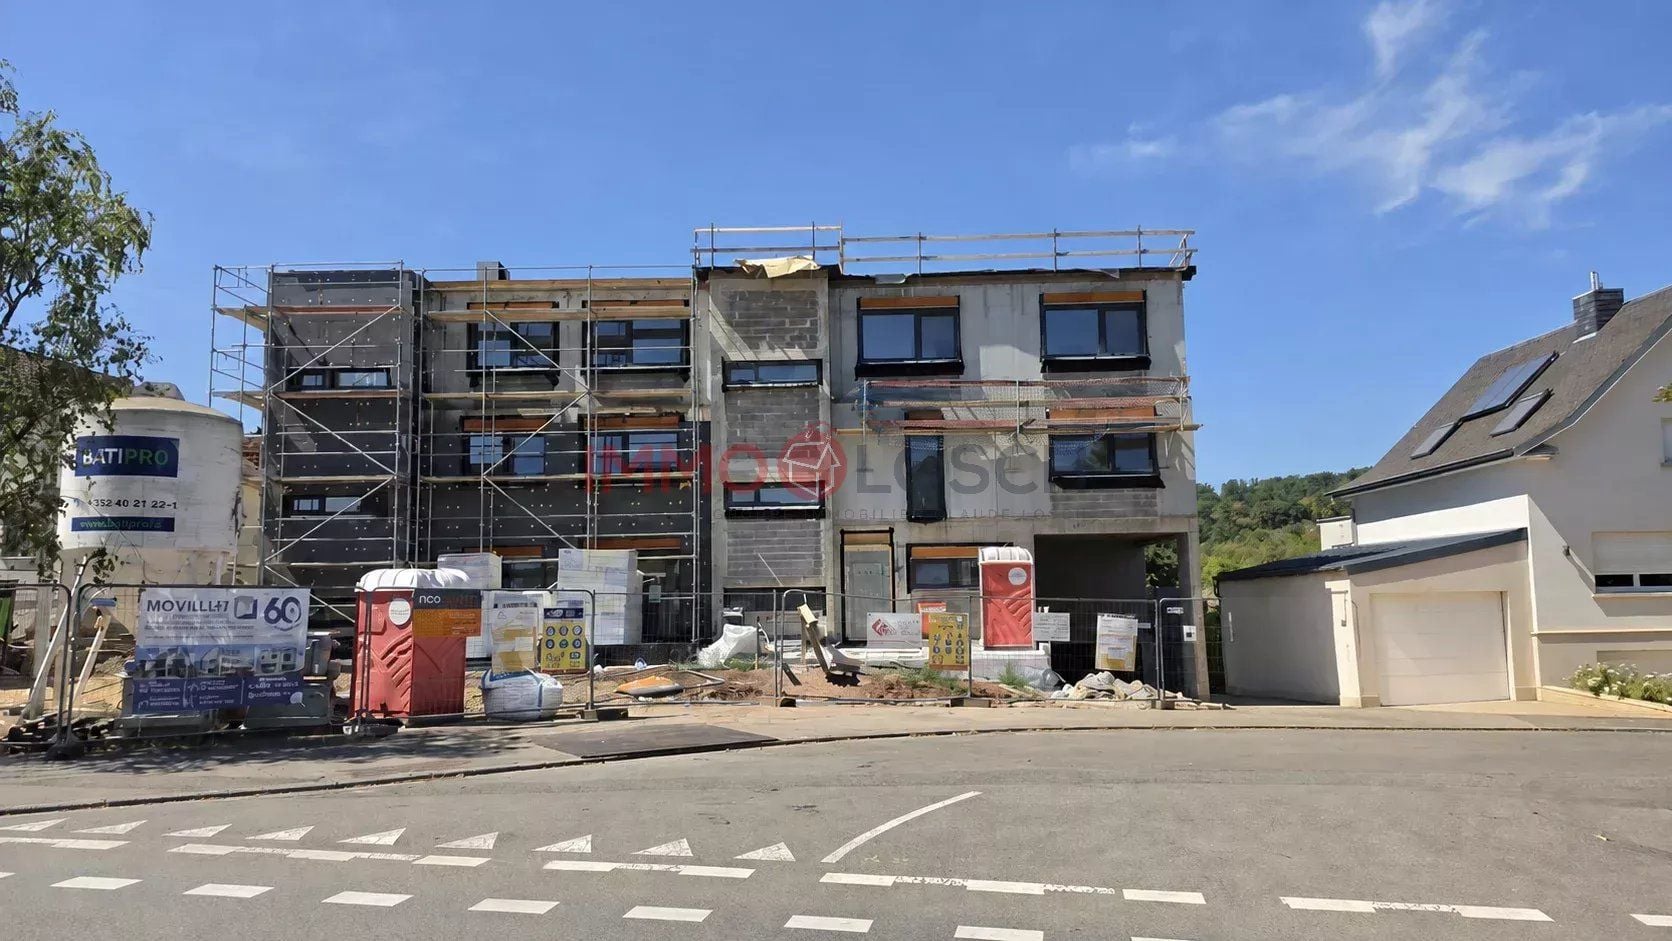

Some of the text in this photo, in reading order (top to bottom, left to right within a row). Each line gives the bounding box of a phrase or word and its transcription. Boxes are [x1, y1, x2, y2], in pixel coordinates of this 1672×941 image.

[82, 448, 168, 465] BATIPRO
[115, 499, 129, 508] 40
[133, 499, 146, 508] 21
[151, 500, 177, 509] 22-1
[264, 597, 302, 625] 60
